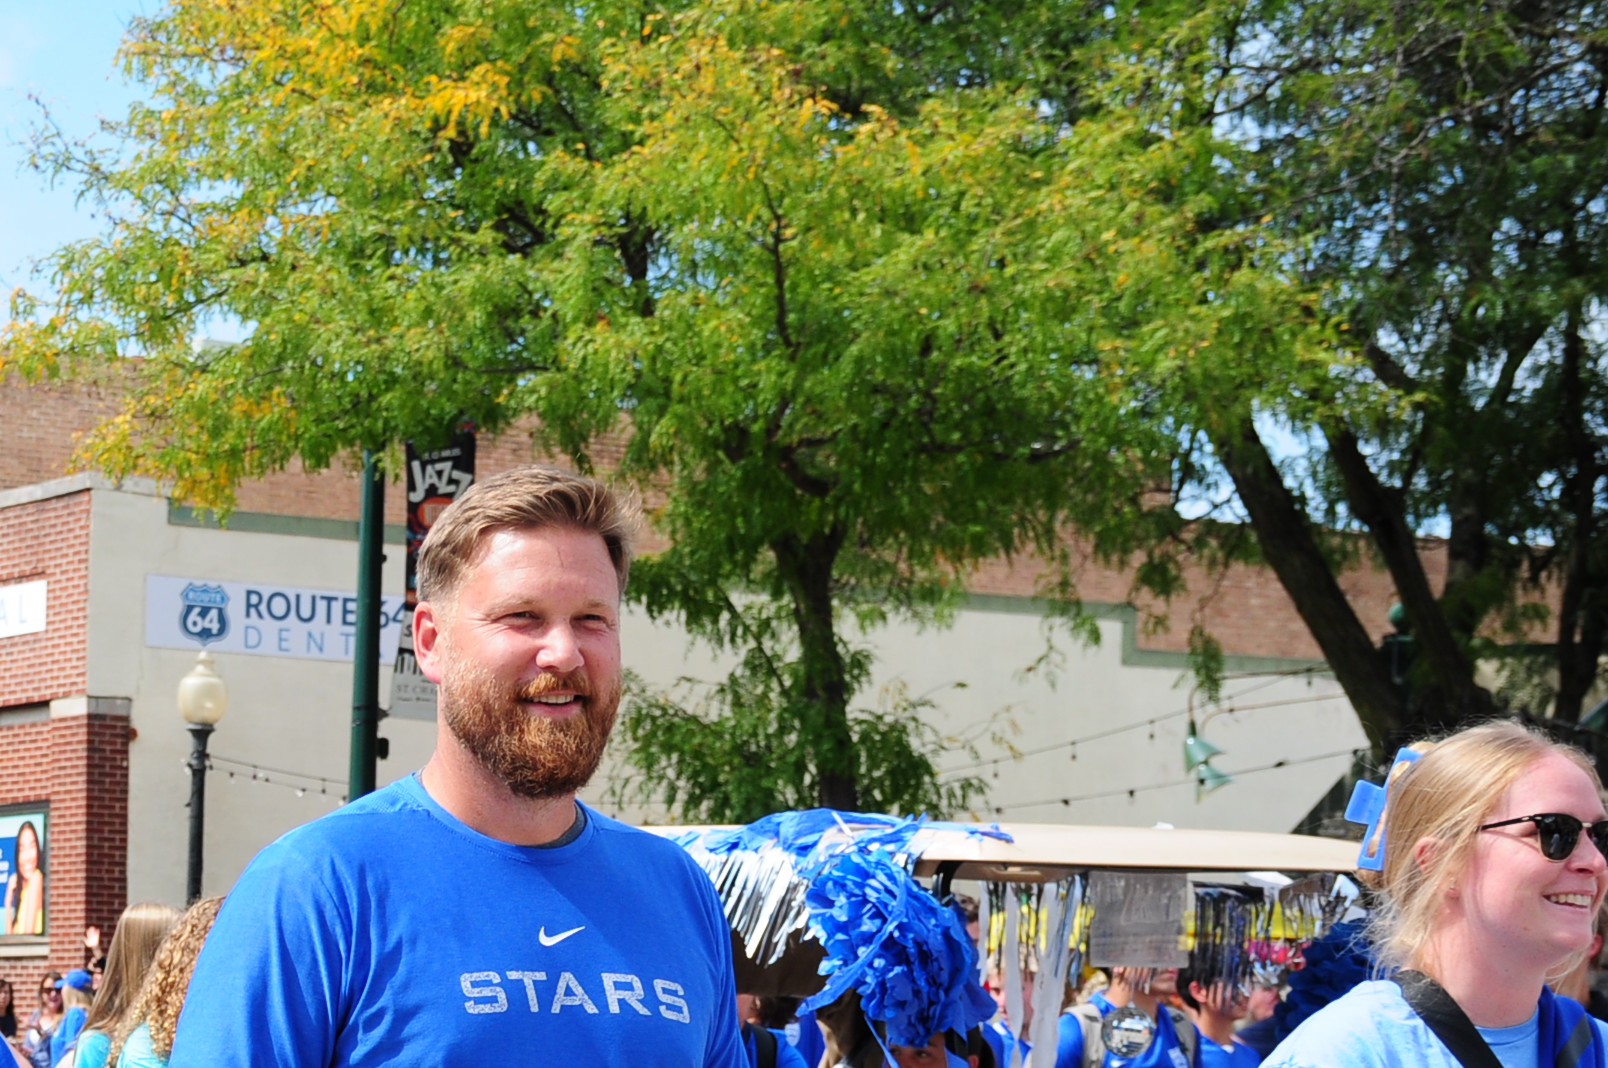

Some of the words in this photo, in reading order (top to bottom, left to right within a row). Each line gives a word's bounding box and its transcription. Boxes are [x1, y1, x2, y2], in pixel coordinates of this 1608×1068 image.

[408, 459, 474, 503] JAZZ
[185, 605, 221, 635] 64
[244, 589, 357, 627] ROUTE
[243, 624, 358, 656] DENT
[459, 969, 691, 1024] STARS
